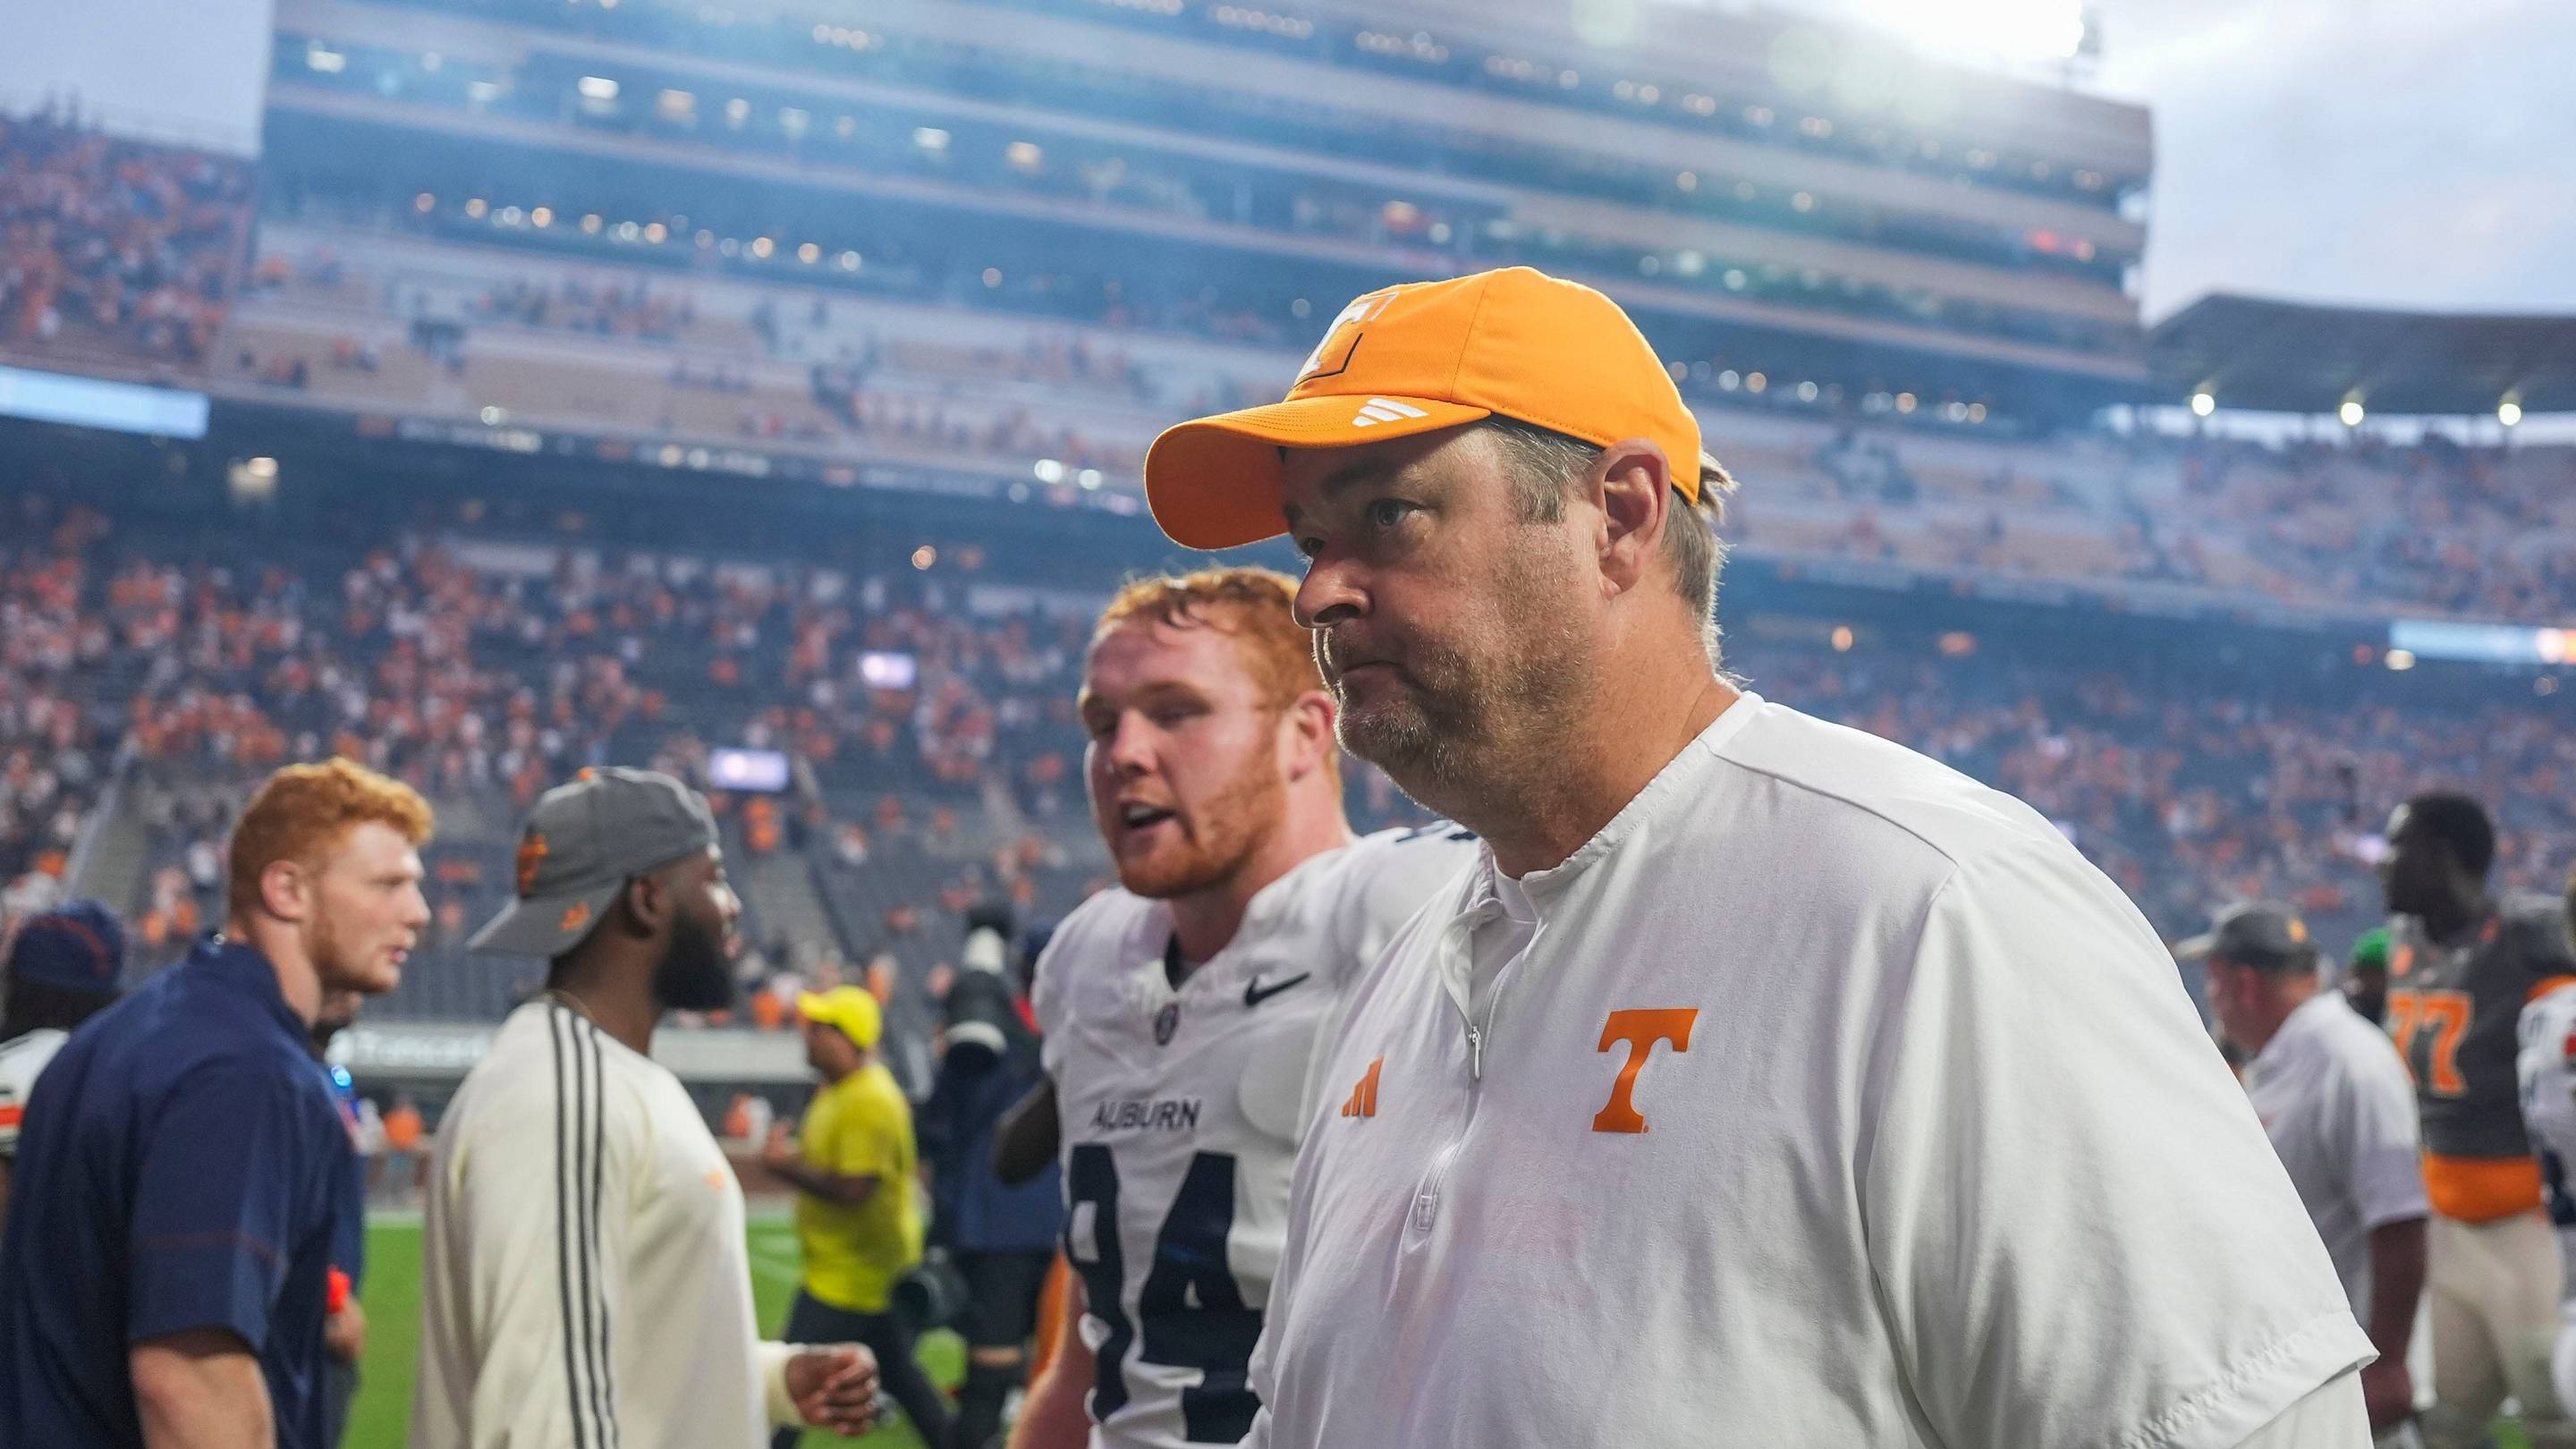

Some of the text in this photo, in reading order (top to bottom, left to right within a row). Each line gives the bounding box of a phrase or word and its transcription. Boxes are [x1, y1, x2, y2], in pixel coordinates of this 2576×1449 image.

[1592, 1009, 1699, 1134] T
[2387, 989, 2473, 1095] 77
[1089, 1098, 1202, 1131] AUBURN
